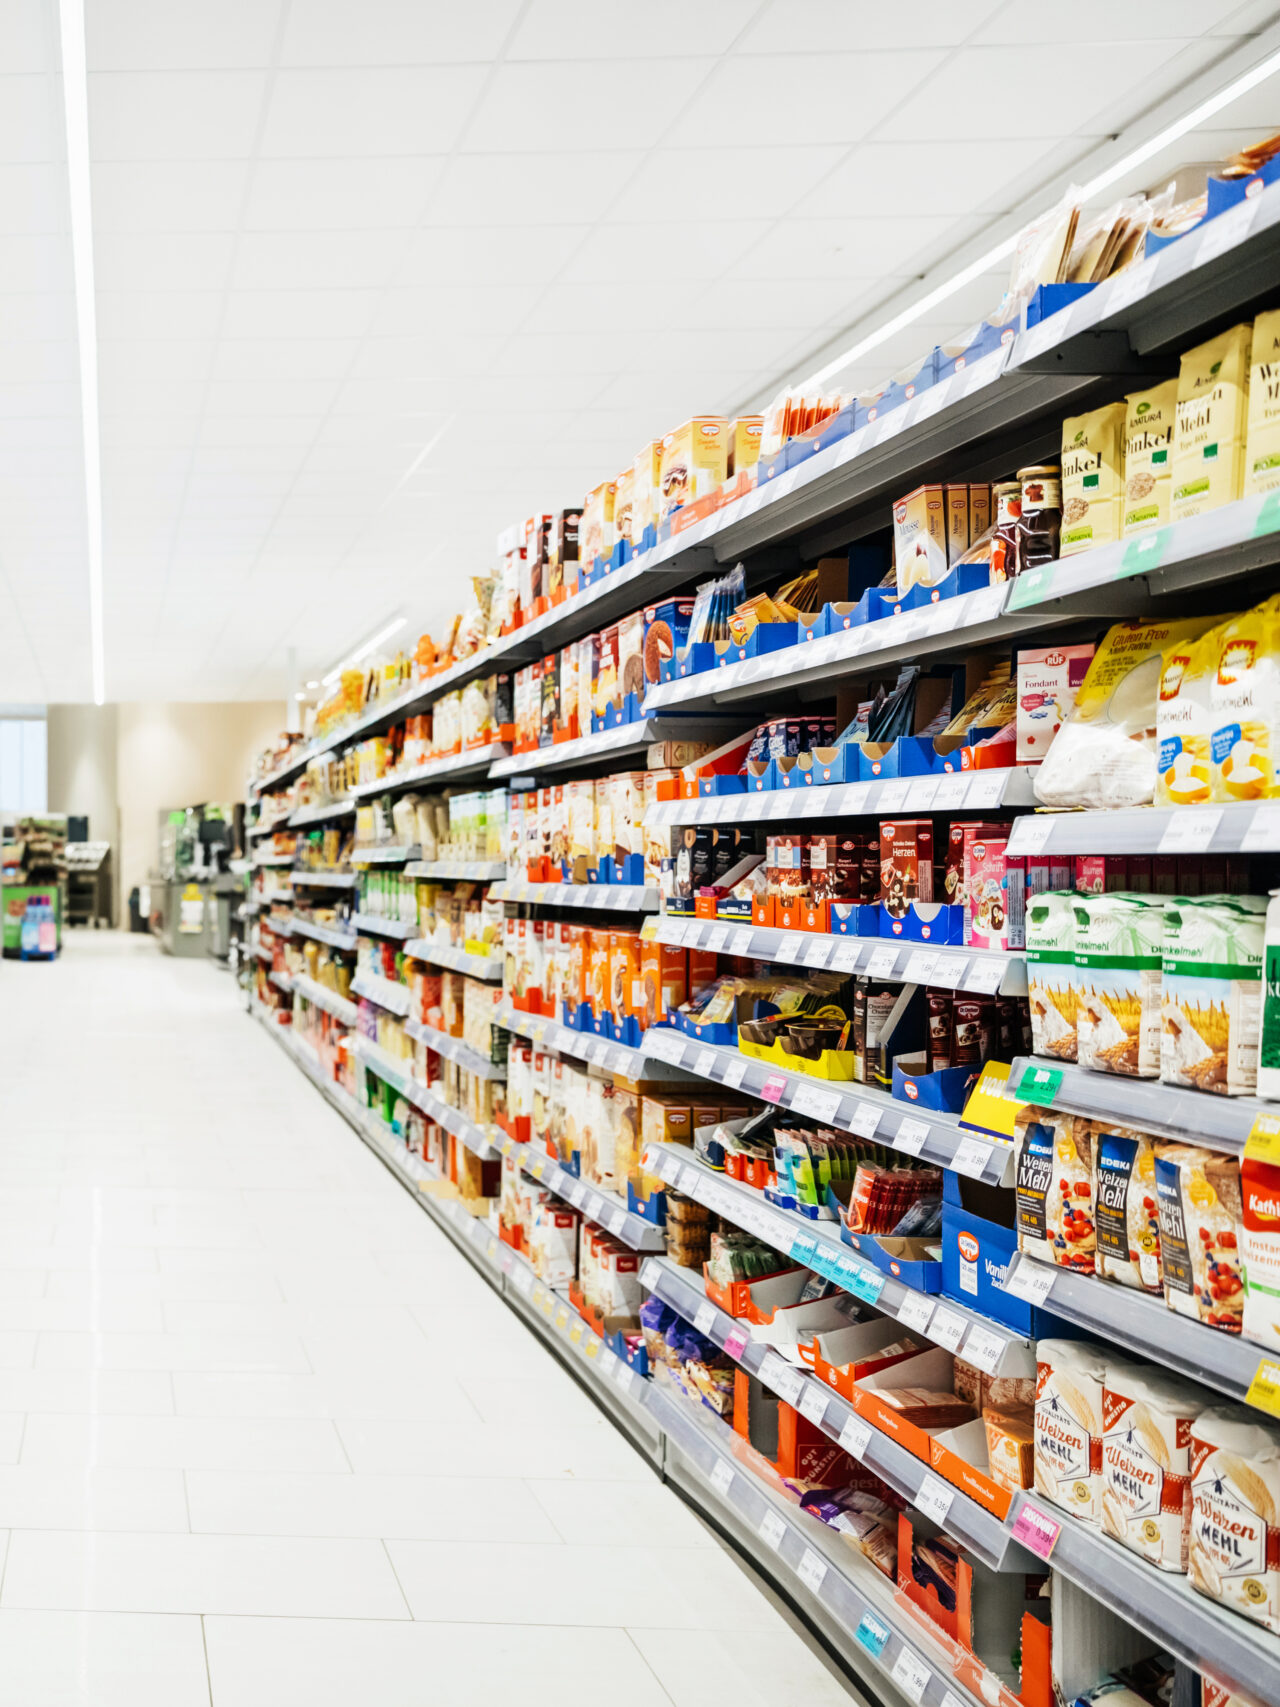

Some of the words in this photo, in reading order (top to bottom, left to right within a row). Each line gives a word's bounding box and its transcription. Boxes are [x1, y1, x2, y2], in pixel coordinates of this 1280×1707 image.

[1064, 451, 1102, 472] inkel
[1112, 632, 1143, 647] Gluten
[1145, 629, 1169, 641] Free
[1025, 680, 1058, 688] Fondant
[892, 848, 916, 858] Herzen
[1076, 941, 1109, 951] inkelmehl
[1162, 945, 1204, 957] inkelmehl
[1022, 1153, 1052, 1173] Weizen
[1100, 1156, 1130, 1171] EDEKA
[1018, 1166, 1051, 1192] Mehl
[1160, 1199, 1181, 1217] eizen
[1035, 1412, 1084, 1450] Weizen
[802, 1449, 818, 1466] GUT
[1041, 1436, 1074, 1463] MEHL
[1105, 1446, 1156, 1485] Weizen
[1113, 1469, 1144, 1500] MEHL
[1195, 1496, 1257, 1541] Weizen
[1201, 1521, 1242, 1557] MEHL
